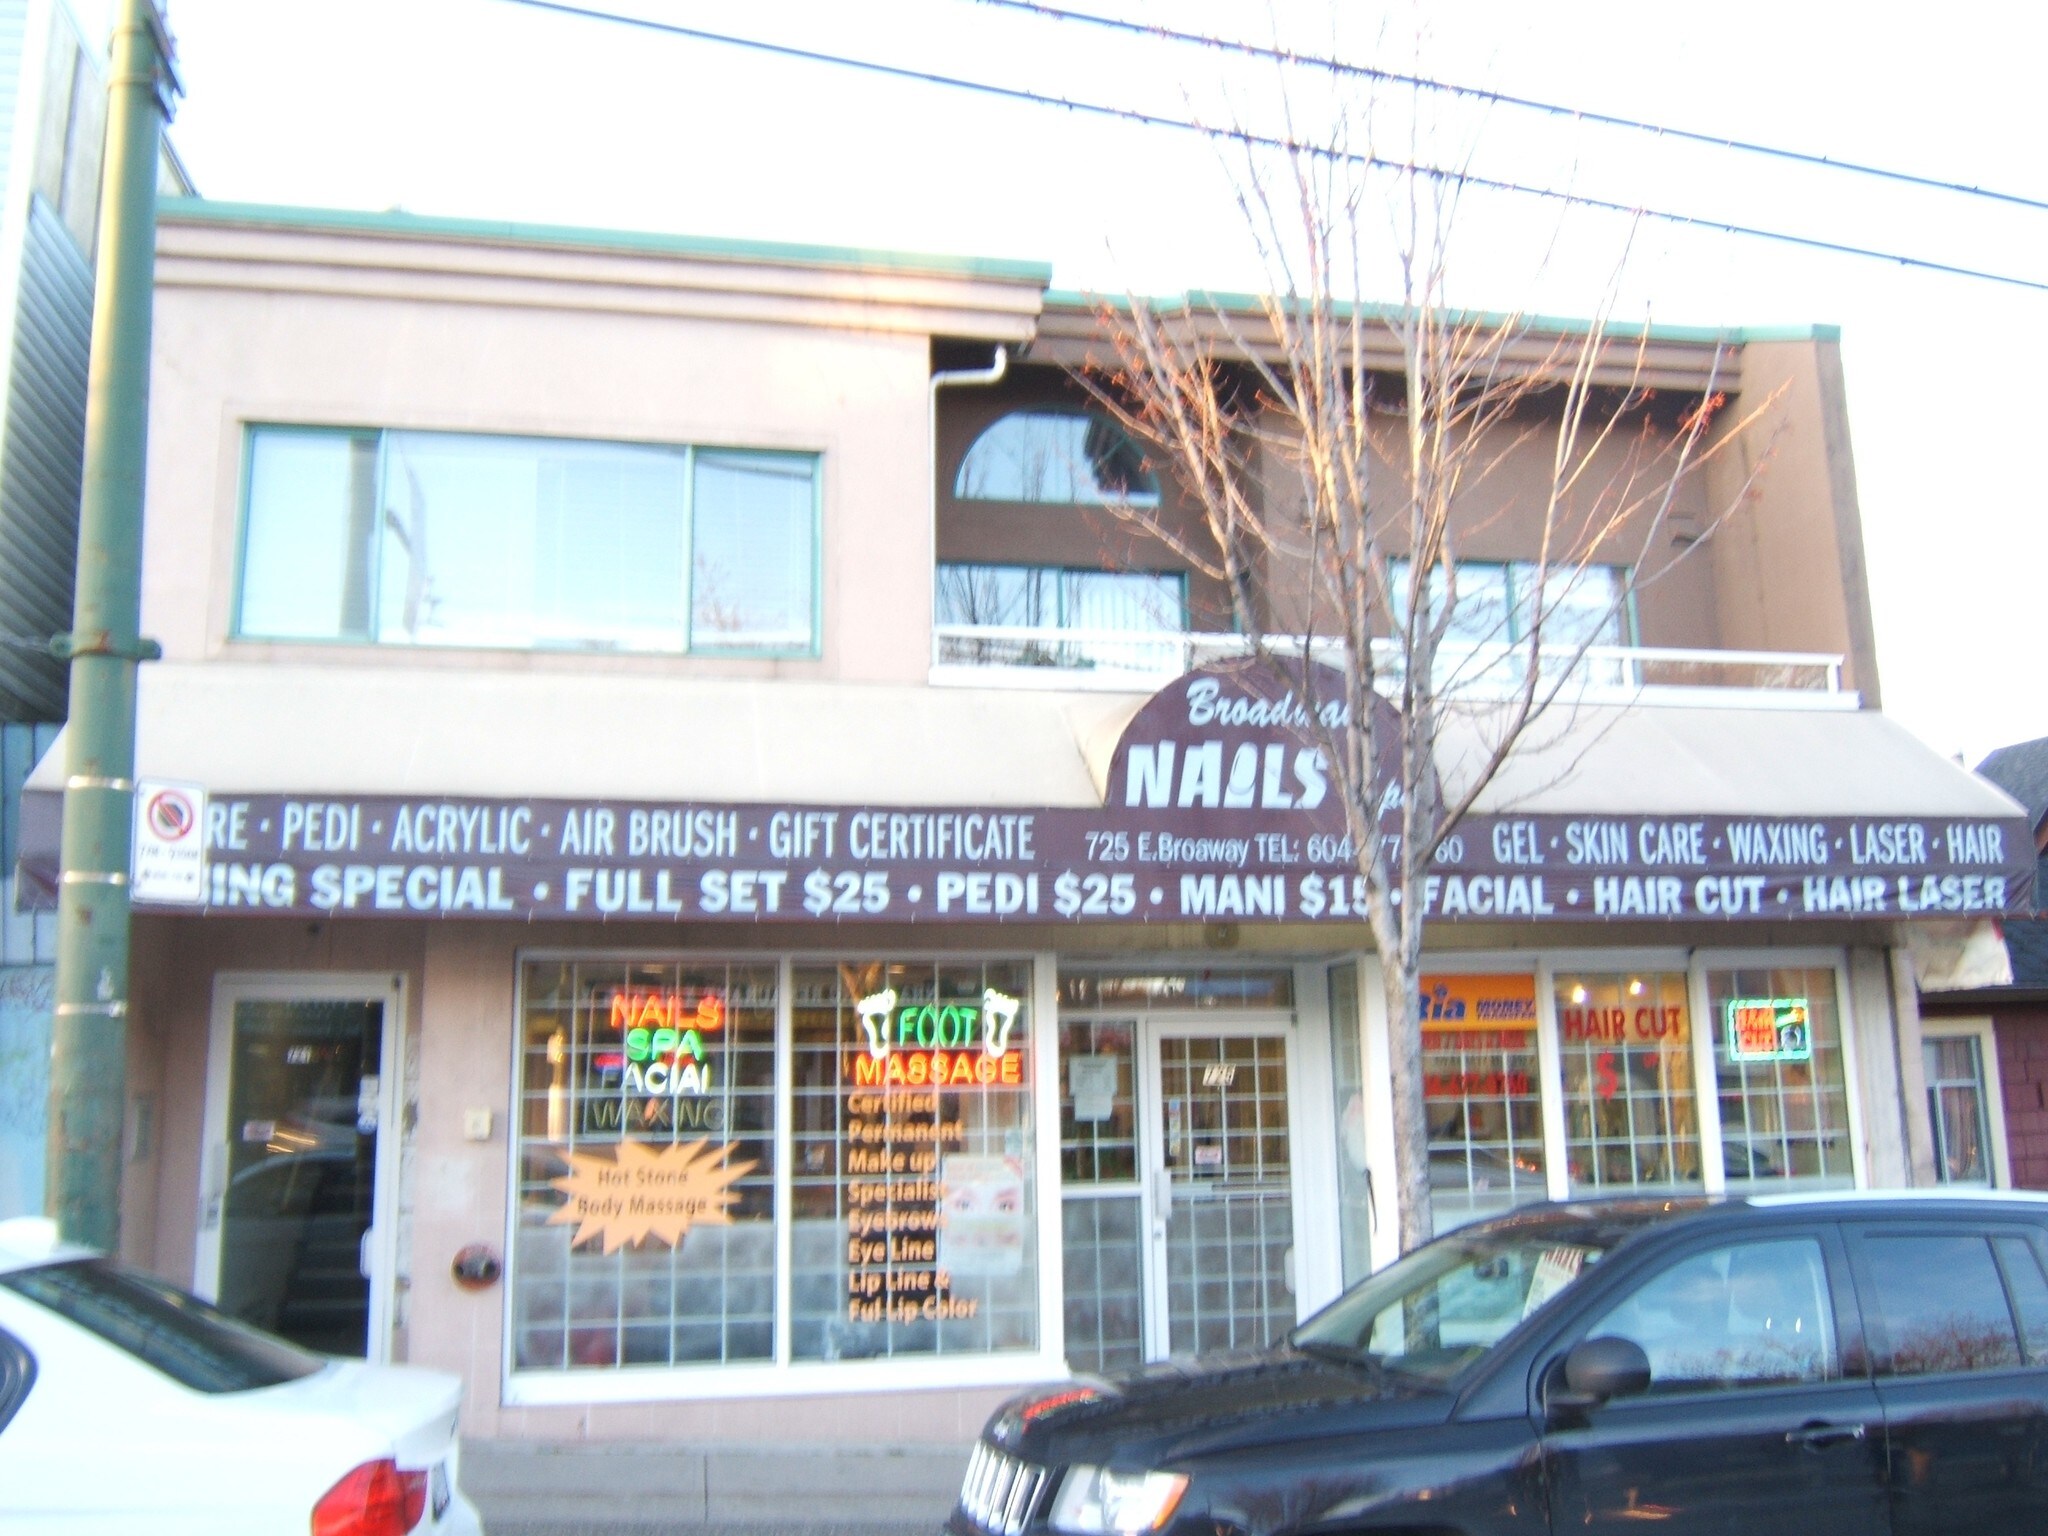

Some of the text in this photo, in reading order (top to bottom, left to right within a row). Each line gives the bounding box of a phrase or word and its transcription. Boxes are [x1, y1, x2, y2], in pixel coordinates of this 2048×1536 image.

[1125, 739, 1329, 810] NAILS
[281, 801, 360, 851] PEDI
[391, 804, 531, 855] ACRYLIC
[559, 807, 614, 856] AIR
[628, 809, 738, 857] BRUSH
[769, 811, 839, 858] GIFT
[849, 811, 1036, 860] CERTIFICATE
[1085, 831, 1129, 862] 725
[1492, 821, 2003, 865] GEL SKIN CARE WAXING LASER HAIR
[309, 864, 513, 910] SPECIAL
[565, 868, 683, 912] FULL
[700, 868, 787, 913] SET
[803, 867, 890, 917] $25
[936, 871, 1039, 914] PEDI
[1053, 869, 1137, 917] $25
[1180, 873, 1285, 916] MANI
[1594, 875, 1682, 915] HAIR
[1694, 875, 1766, 915] CUT
[1803, 875, 1887, 913] HAIR
[1897, 875, 2008, 912] LASER
[610, 993, 724, 1029] NAILS
[900, 1004, 977, 1048] FOOT
[1563, 1006, 1626, 1041] HAIR
[1635, 1006, 1681, 1041] CUT
[625, 1027, 703, 1061] SPA
[855, 1051, 1022, 1087] MASSAGE
[848, 1118, 964, 1143] Permanent
[598, 1164, 690, 1186] Hot Stone
[848, 1147, 906, 1173] Make
[909, 1152, 937, 1178] up
[577, 1194, 708, 1219] Body Massage
[848, 1237, 888, 1266] Eye
[890, 1235, 936, 1261] Line
[848, 1267, 951, 1297] Lip Line &
[886, 1296, 919, 1326] Lip
[922, 1294, 978, 1320] Color
